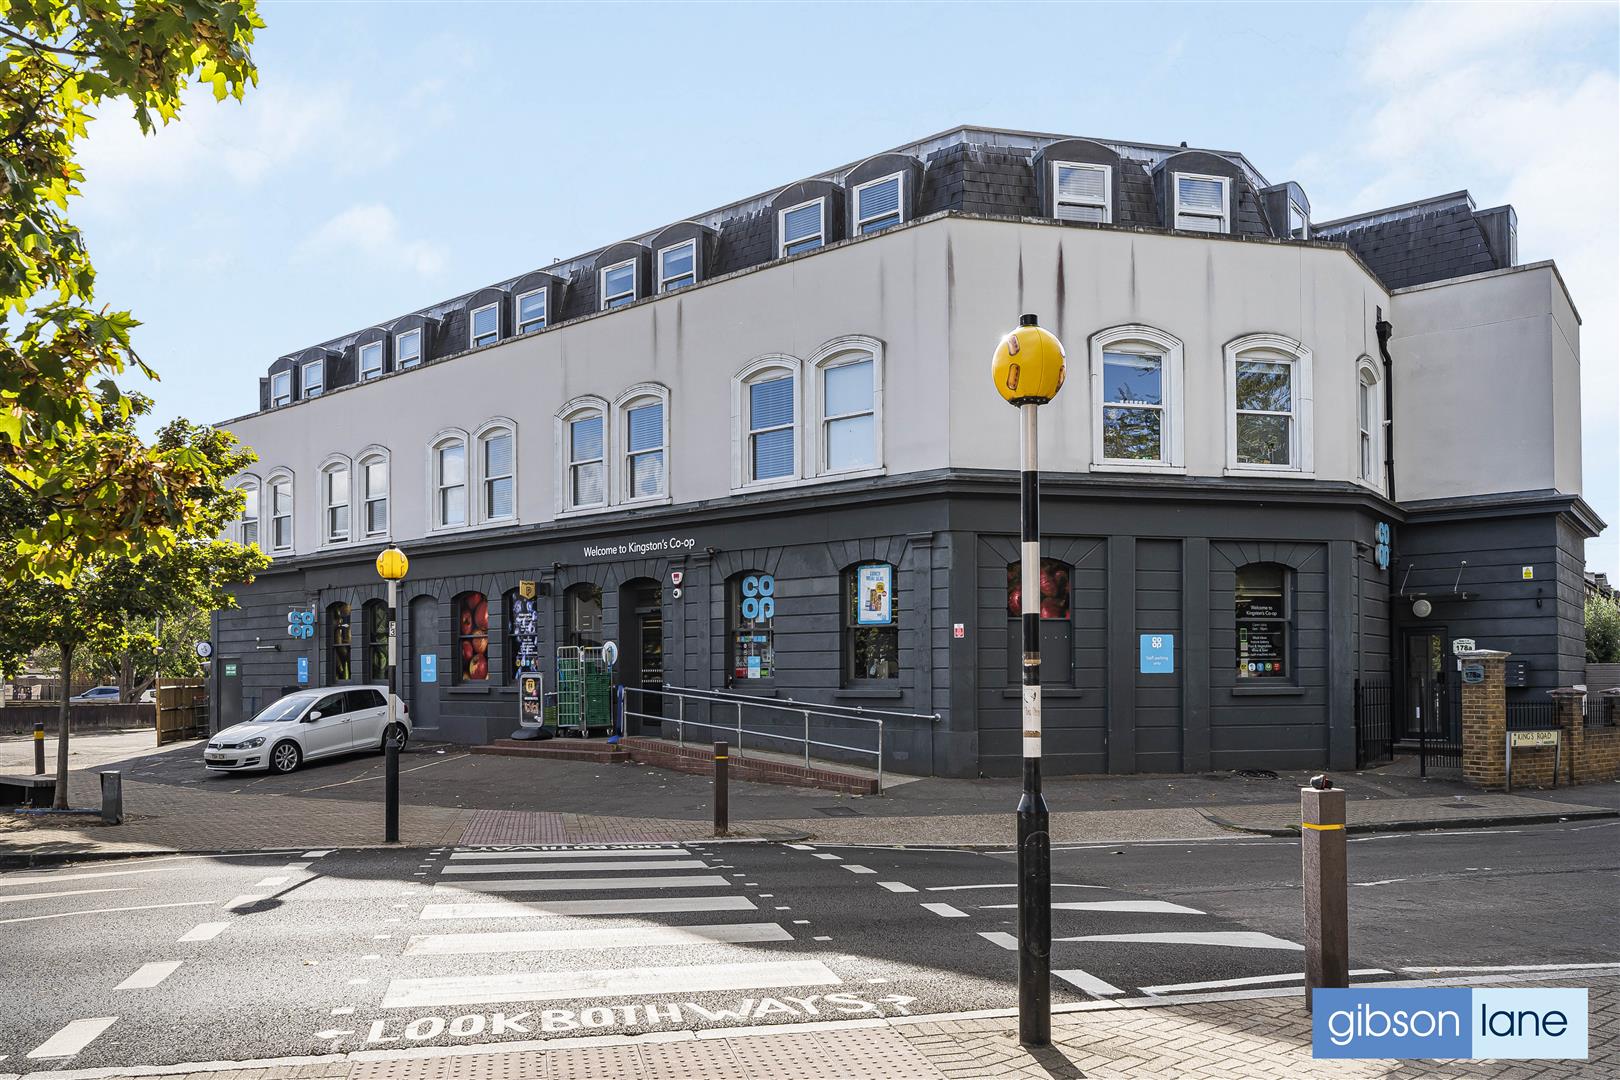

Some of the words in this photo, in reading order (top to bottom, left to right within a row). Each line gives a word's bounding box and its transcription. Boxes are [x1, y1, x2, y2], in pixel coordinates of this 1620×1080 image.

[583, 546, 617, 557] Welcome
[619, 545, 627, 554] to
[628, 539, 668, 555] Kingston's
[669, 537, 696, 550] Co-op
[1536, 732, 1552, 740] ROAD
[366, 1011, 538, 1044] LOOK
[541, 1003, 683, 1033] BOTH
[683, 992, 873, 1022] WAYS
